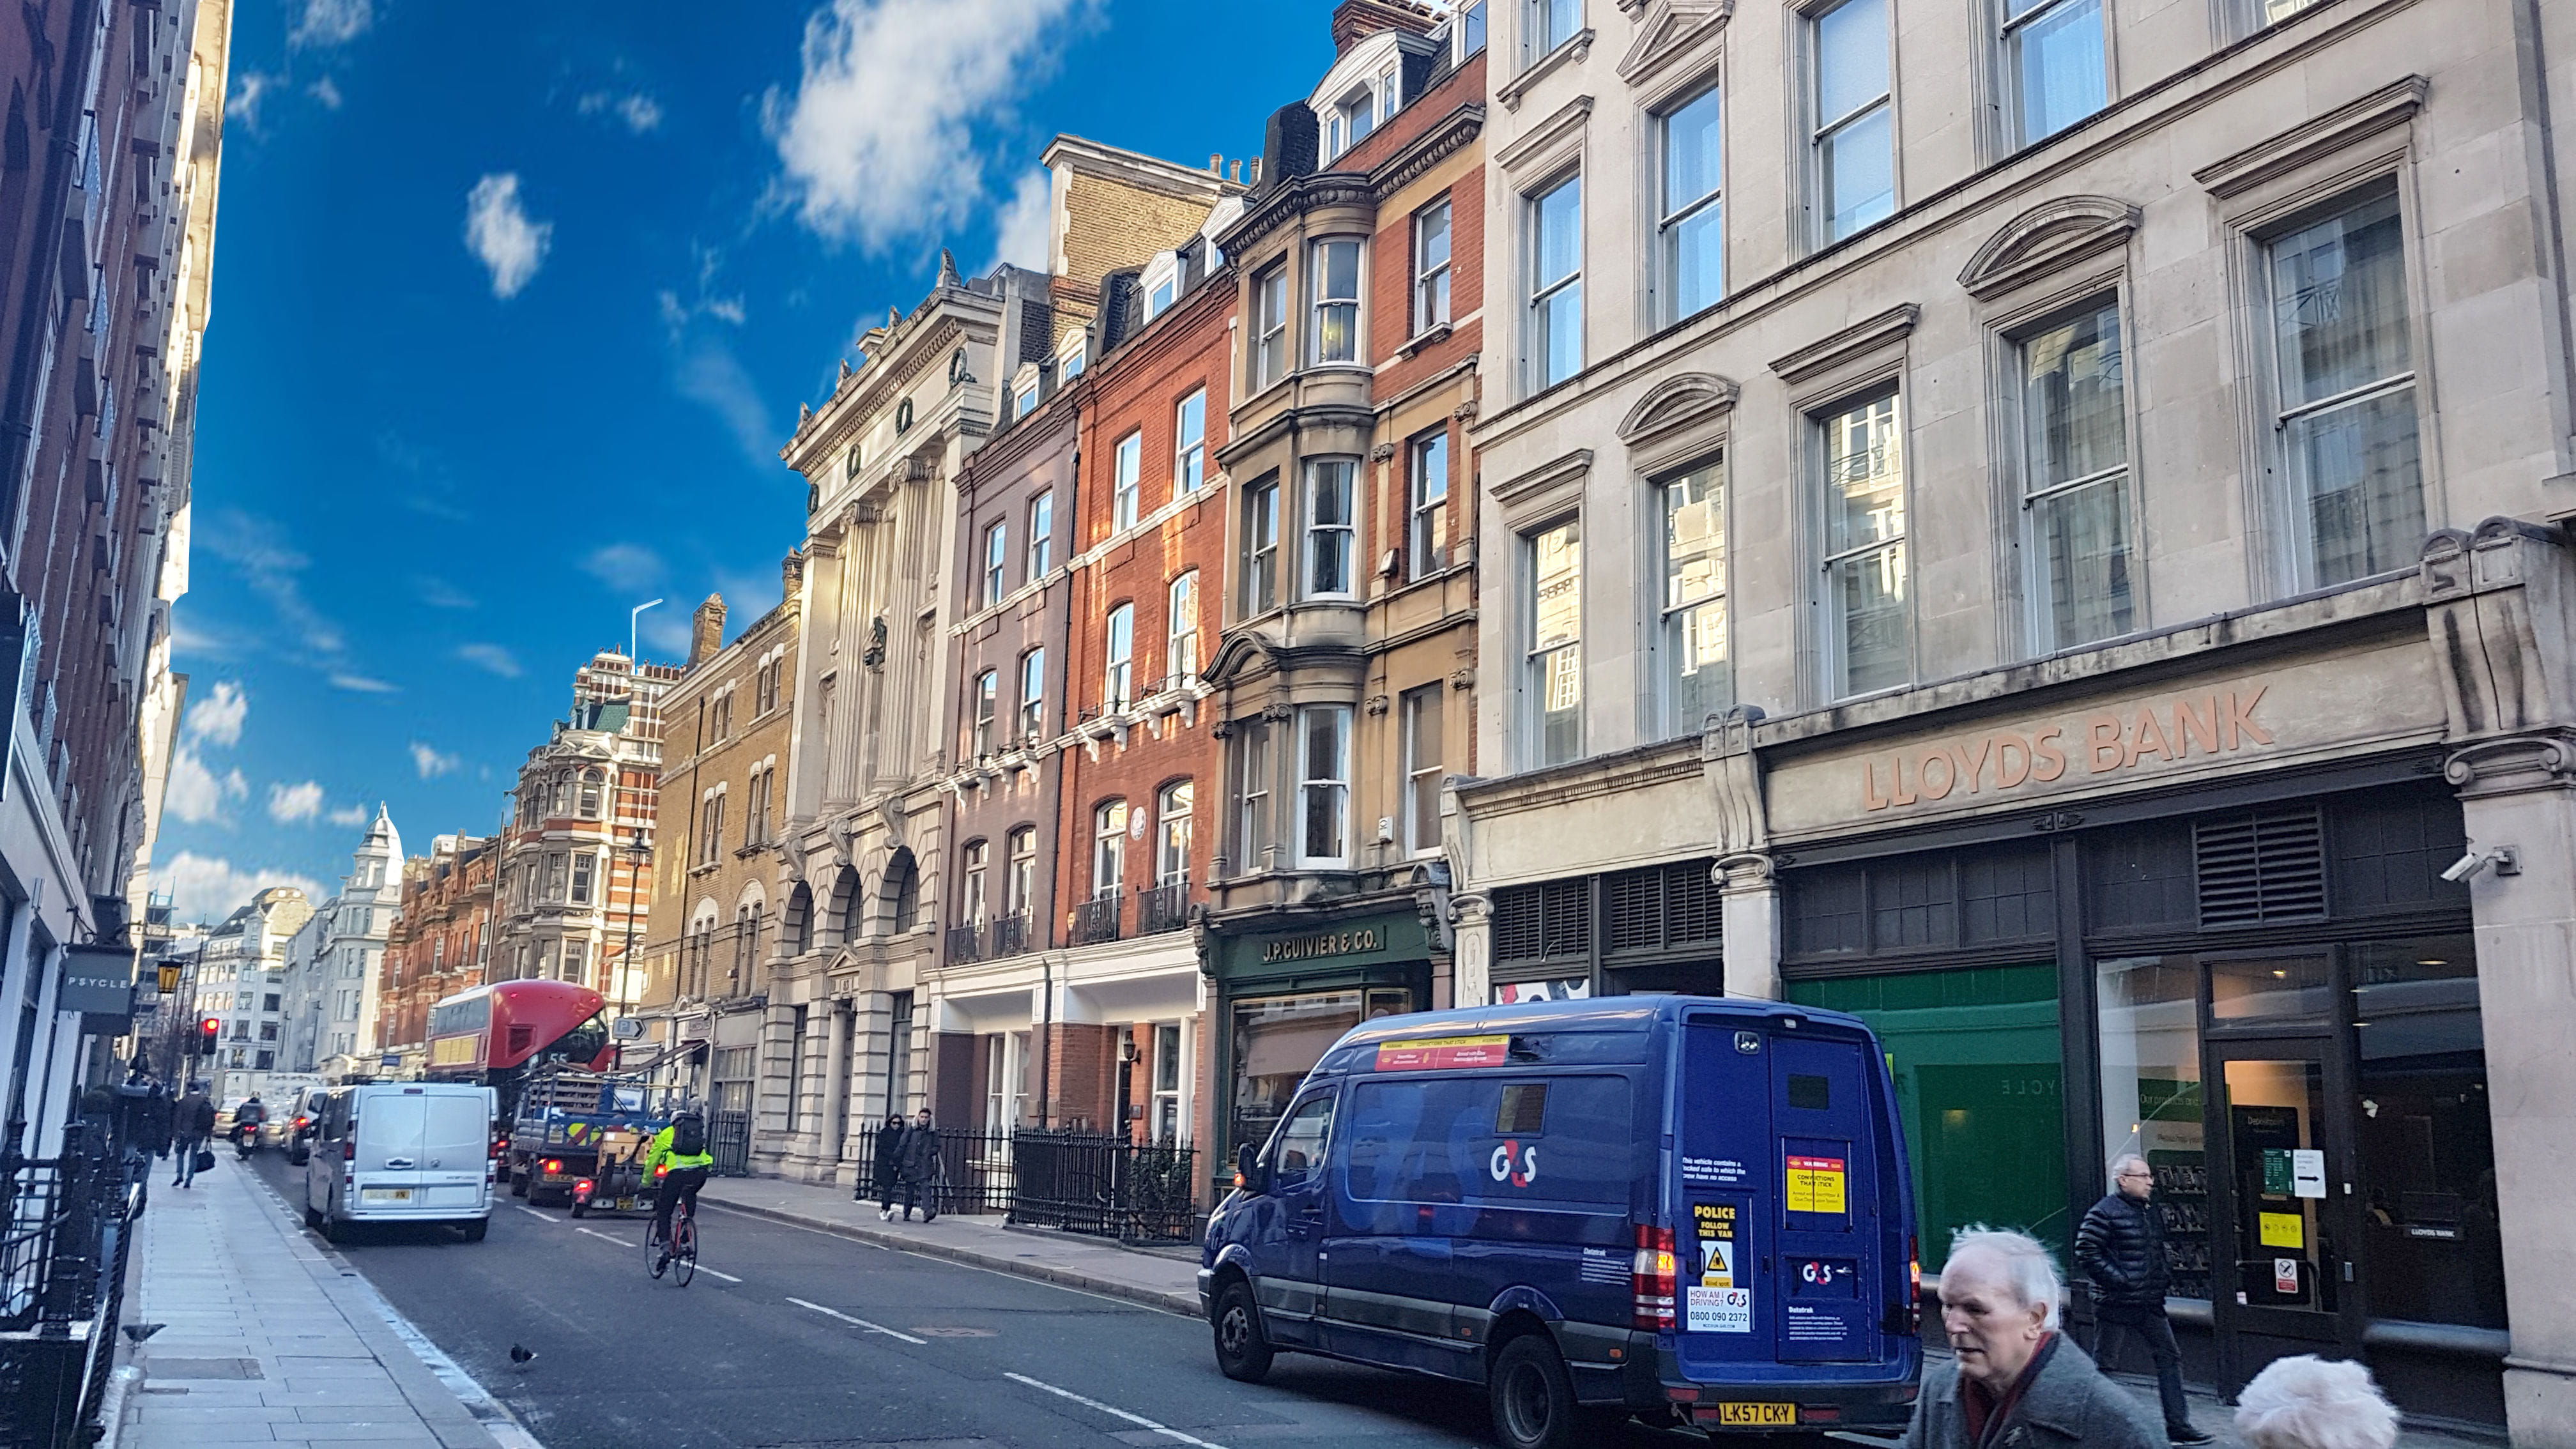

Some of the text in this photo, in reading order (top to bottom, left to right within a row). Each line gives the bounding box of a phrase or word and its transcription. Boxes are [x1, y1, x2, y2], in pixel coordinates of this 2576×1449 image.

[1863, 686, 2274, 811] LLOYDS BANK
[1341, 933, 1350, 952] &
[1354, 930, 1377, 950] CO.
[68, 977, 128, 988] PSYCLE
[1491, 1140, 1537, 1188] G4S
[1694, 1206, 1736, 1220] POLICE
[1701, 1221, 1729, 1230] FOLLOW
[1698, 1229, 1733, 1238] THIS VAN
[1803, 1262, 1832, 1285] G4S
[1690, 1298, 1724, 1307] DRIVING?
[1727, 1292, 1747, 1307] G4S
[1690, 1311, 1747, 1322] 0800 090 2372
[1723, 1404, 1790, 1422] LK57 CKY
